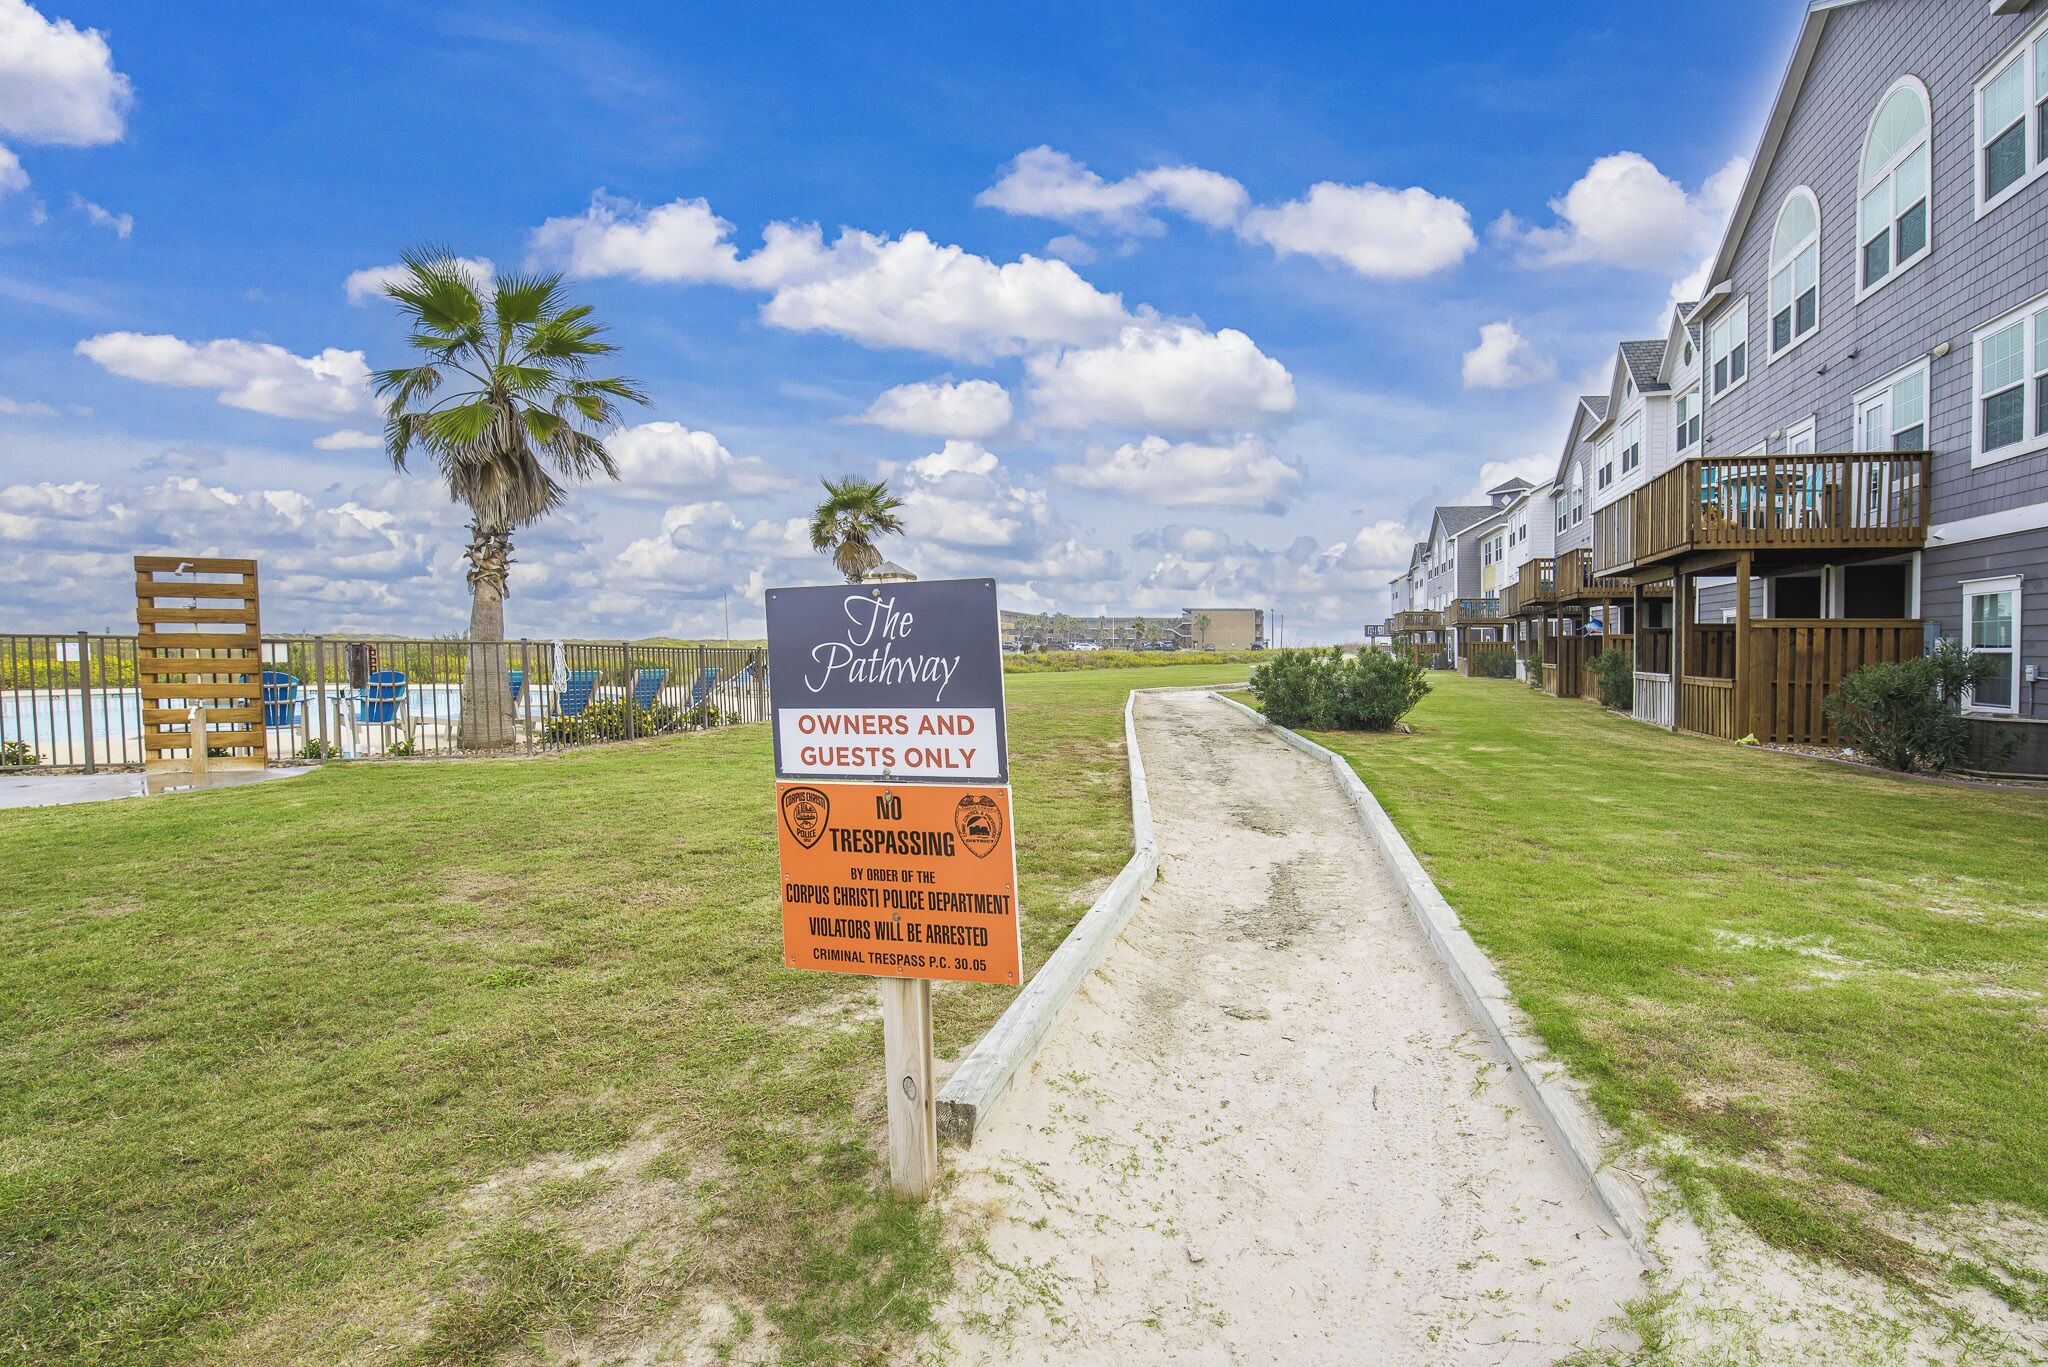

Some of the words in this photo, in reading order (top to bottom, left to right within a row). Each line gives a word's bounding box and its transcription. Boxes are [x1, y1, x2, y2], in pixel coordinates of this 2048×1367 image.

[844, 595, 913, 646] The
[804, 642, 960, 702] Pathway
[798, 715, 909, 735] OWNERS
[917, 715, 975, 736] AND
[800, 746, 896, 767] GUESTS
[904, 748, 976, 769] ONLY
[876, 795, 902, 820] NO
[796, 828, 816, 838] POLICE
[829, 828, 955, 856] TRESPASSING
[851, 868, 863, 880] BY
[867, 868, 898, 882] ORDER
[901, 869, 913, 883] OF
[916, 870, 936, 884] THE
[786, 883, 829, 905] CORPUS
[833, 886, 879, 908] CHRISTI
[883, 889, 925, 910] POLICE
[928, 891, 1010, 915] DEPARTMENT
[809, 916, 870, 940] VIOLATORS
[874, 920, 904, 941] WILL
[907, 922, 922, 943] BE
[926, 924, 988, 947] ARRESTED
[813, 947, 865, 963] CRIMINAL
[868, 952, 925, 967] TRESPASS
[929, 956, 951, 969] P.C.
[954, 957, 987, 971] 30.05
